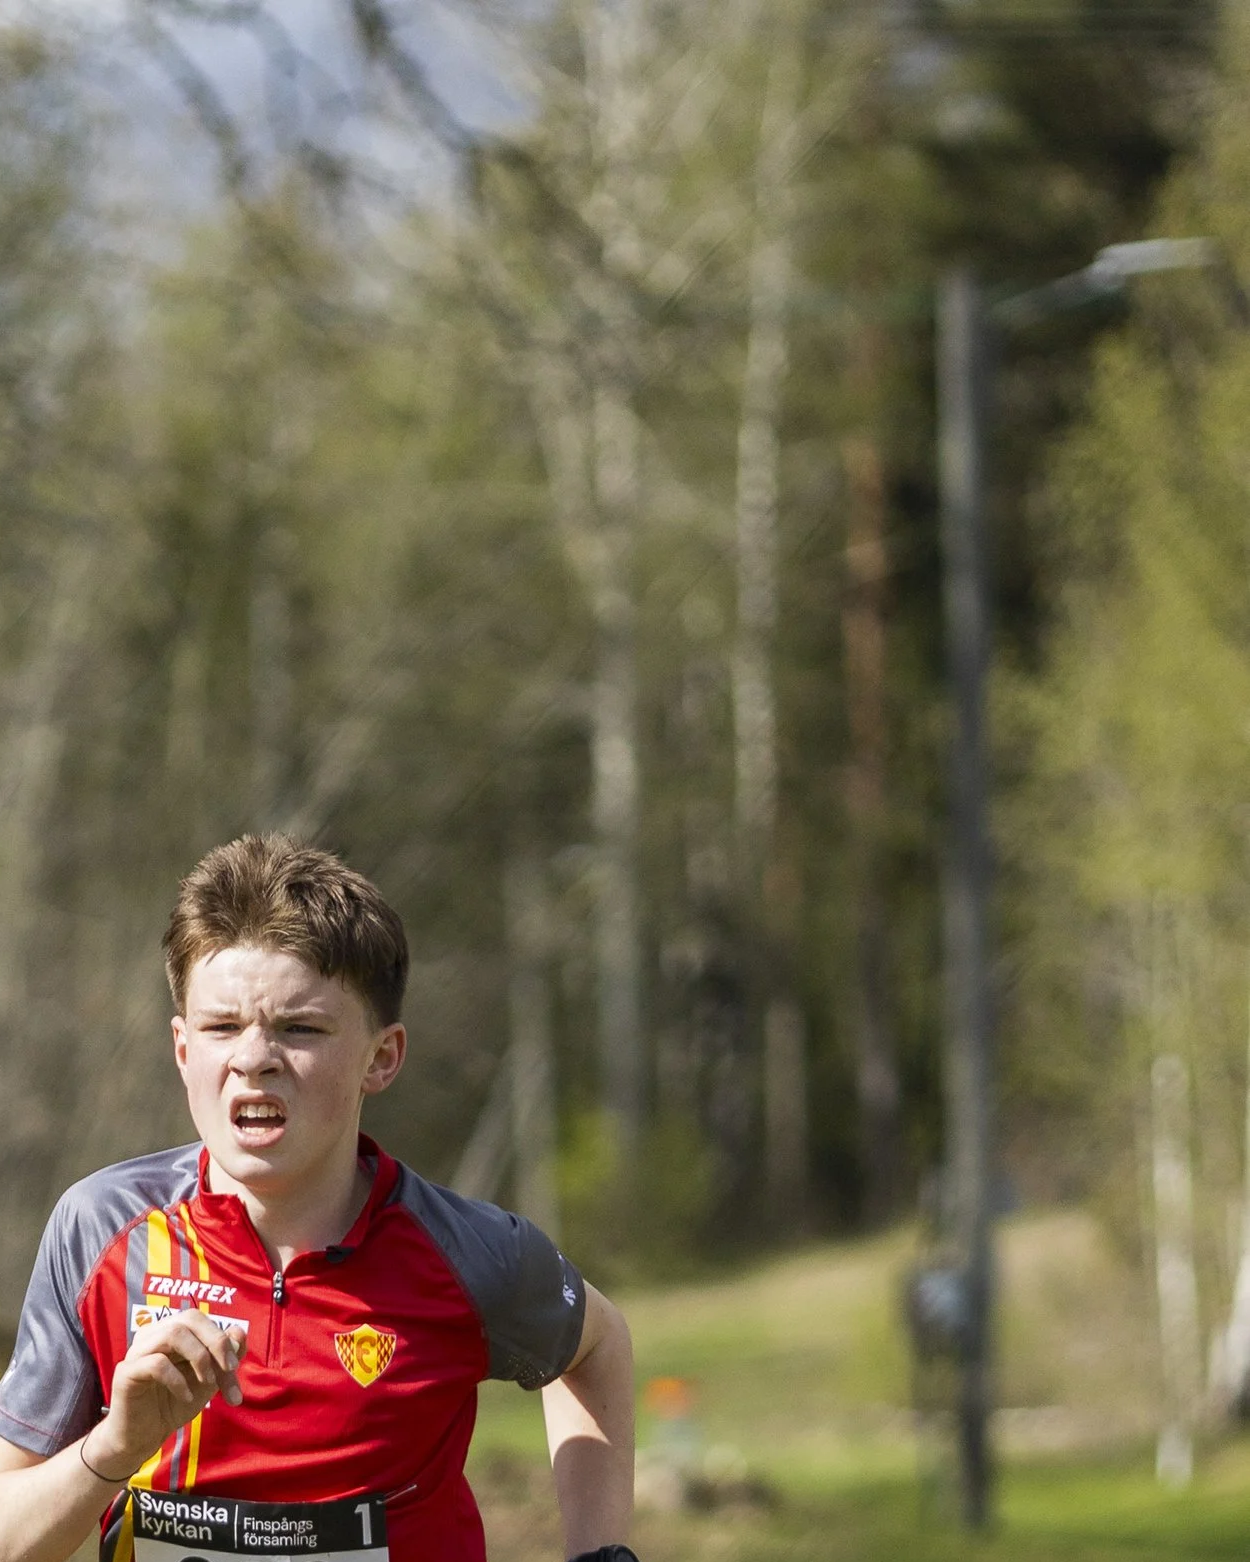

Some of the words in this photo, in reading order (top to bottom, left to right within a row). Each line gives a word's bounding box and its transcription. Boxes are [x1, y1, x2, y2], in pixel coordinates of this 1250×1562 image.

[147, 1275, 237, 1305] TRIMTEX
[139, 1492, 229, 1523] Svenska
[141, 1510, 213, 1541] kyrkan
[243, 1516, 314, 1534] Finspångs
[243, 1531, 318, 1547] församling
[354, 1502, 373, 1546] 1
